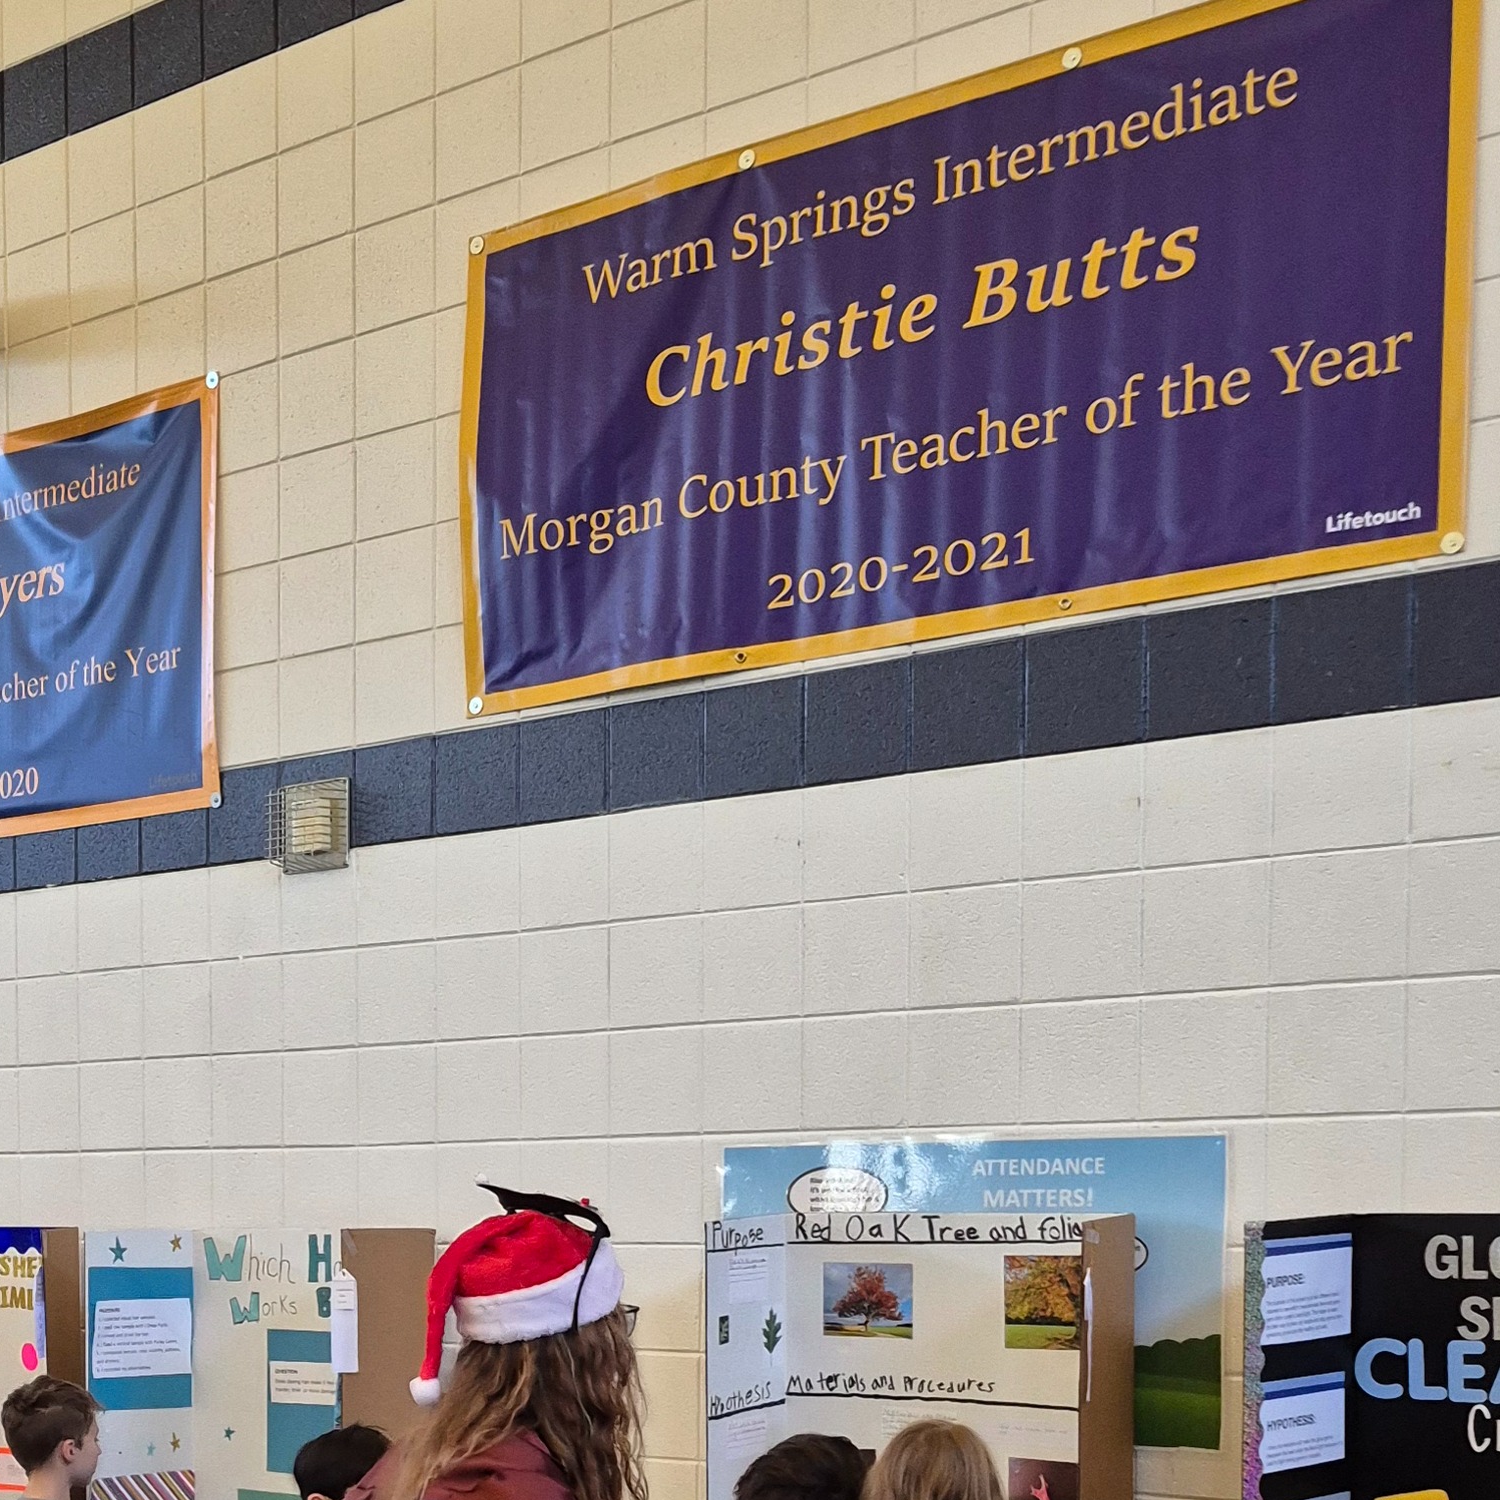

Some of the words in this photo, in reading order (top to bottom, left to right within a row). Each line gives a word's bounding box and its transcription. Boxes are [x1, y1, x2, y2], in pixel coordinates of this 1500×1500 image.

[582, 237, 716, 304] Warm
[730, 176, 916, 270] Springs
[932, 64, 1300, 206] Intermediate
[645, 283, 938, 407] Christie
[962, 222, 1200, 330] Butts
[498, 497, 665, 560] Morgan
[678, 454, 848, 521] County
[861, 402, 1068, 482] Teacher
[1085, 372, 1144, 435] of
[1158, 363, 1252, 420] the
[1270, 329, 1414, 396] Year
[1325, 501, 1422, 534] Lifetouch
[766, 527, 1036, 611] 2020-2021
[54, 661, 78, 691] of
[82, 655, 116, 687] the
[123, 644, 182, 679] Year
[972, 1157, 1106, 1178] ATTENDANCE
[983, 1188, 1094, 1208] MATTERS!
[711, 1220, 765, 1256] Purpose
[795, 1212, 831, 1241] Red
[925, 1215, 980, 1241] Tree
[988, 1218, 1027, 1242] and
[203, 1233, 296, 1284] Which
[229, 1291, 298, 1325] Works
[786, 1372, 866, 1394] Materials
[869, 1373, 896, 1393] and
[902, 1375, 996, 1394] Procedures
